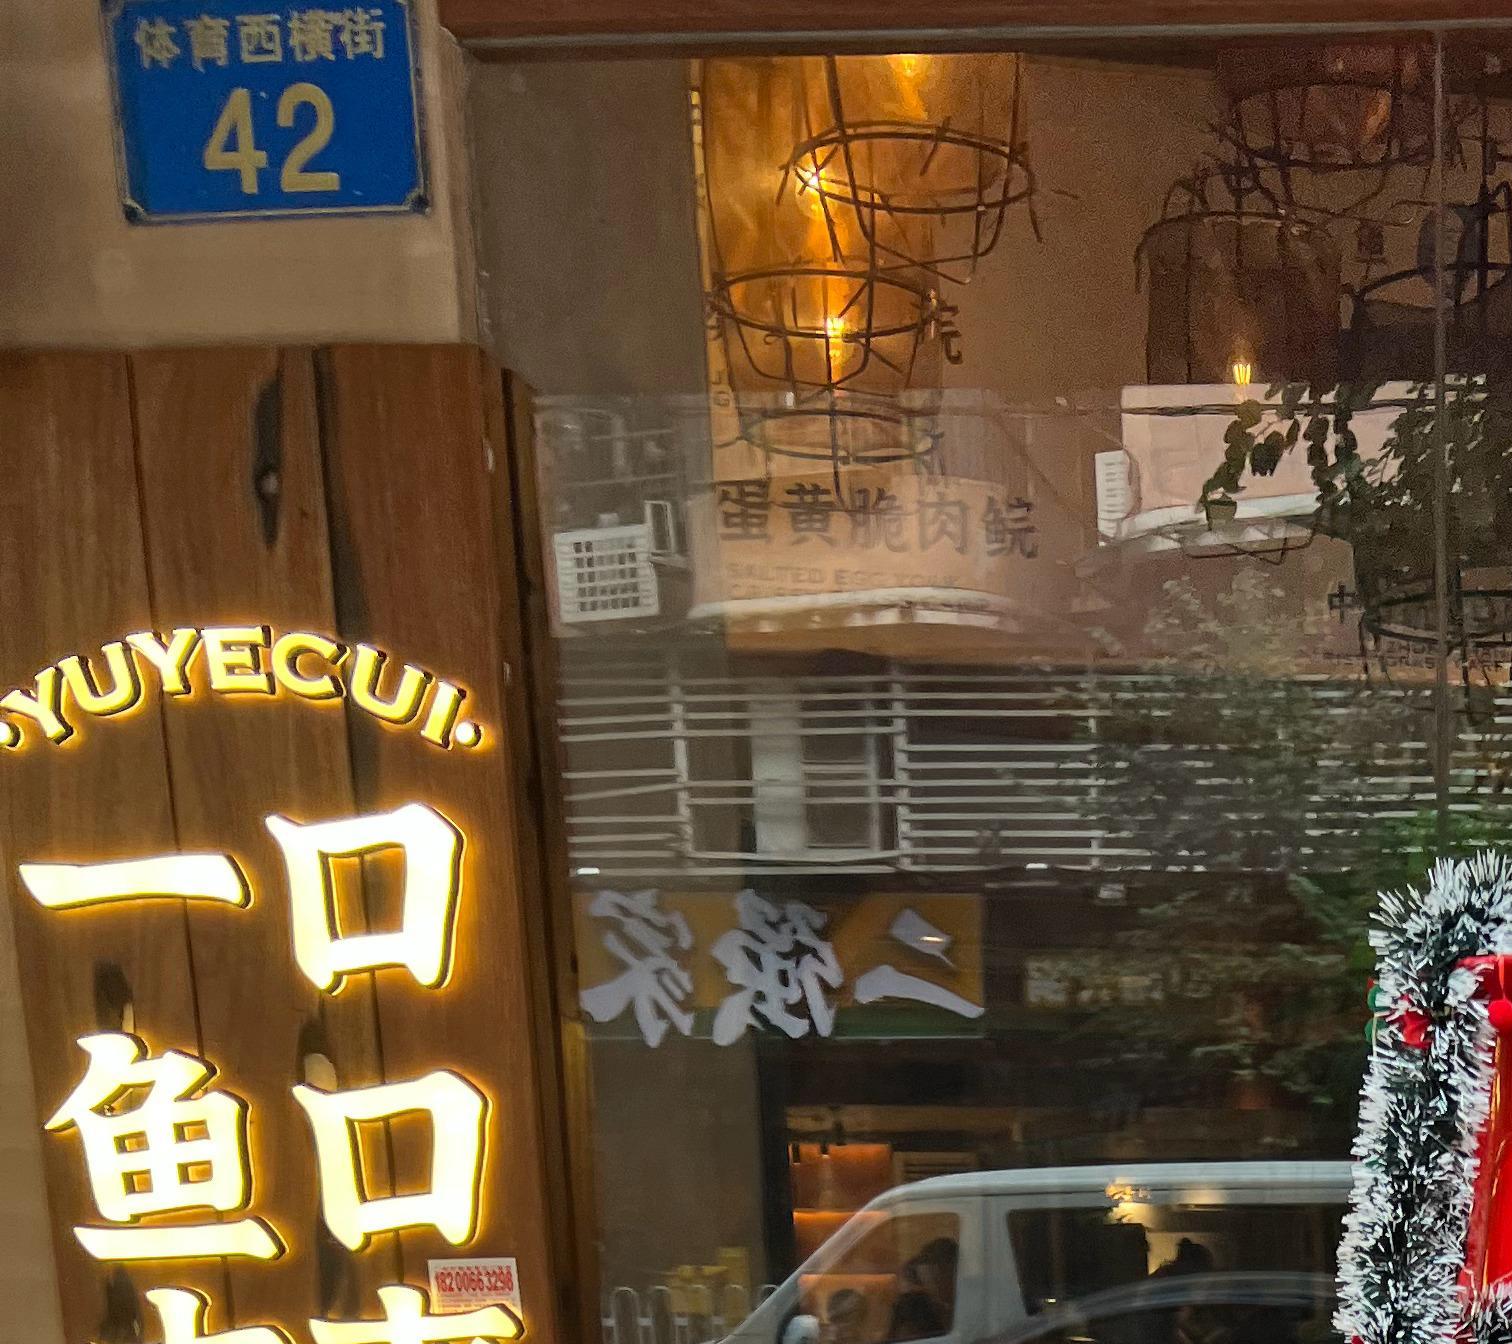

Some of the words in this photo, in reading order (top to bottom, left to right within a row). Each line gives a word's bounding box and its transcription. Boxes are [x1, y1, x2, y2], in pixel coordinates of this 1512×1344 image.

[134, 8, 386, 72] 体育西横街
[204, 82, 341, 195] 42
